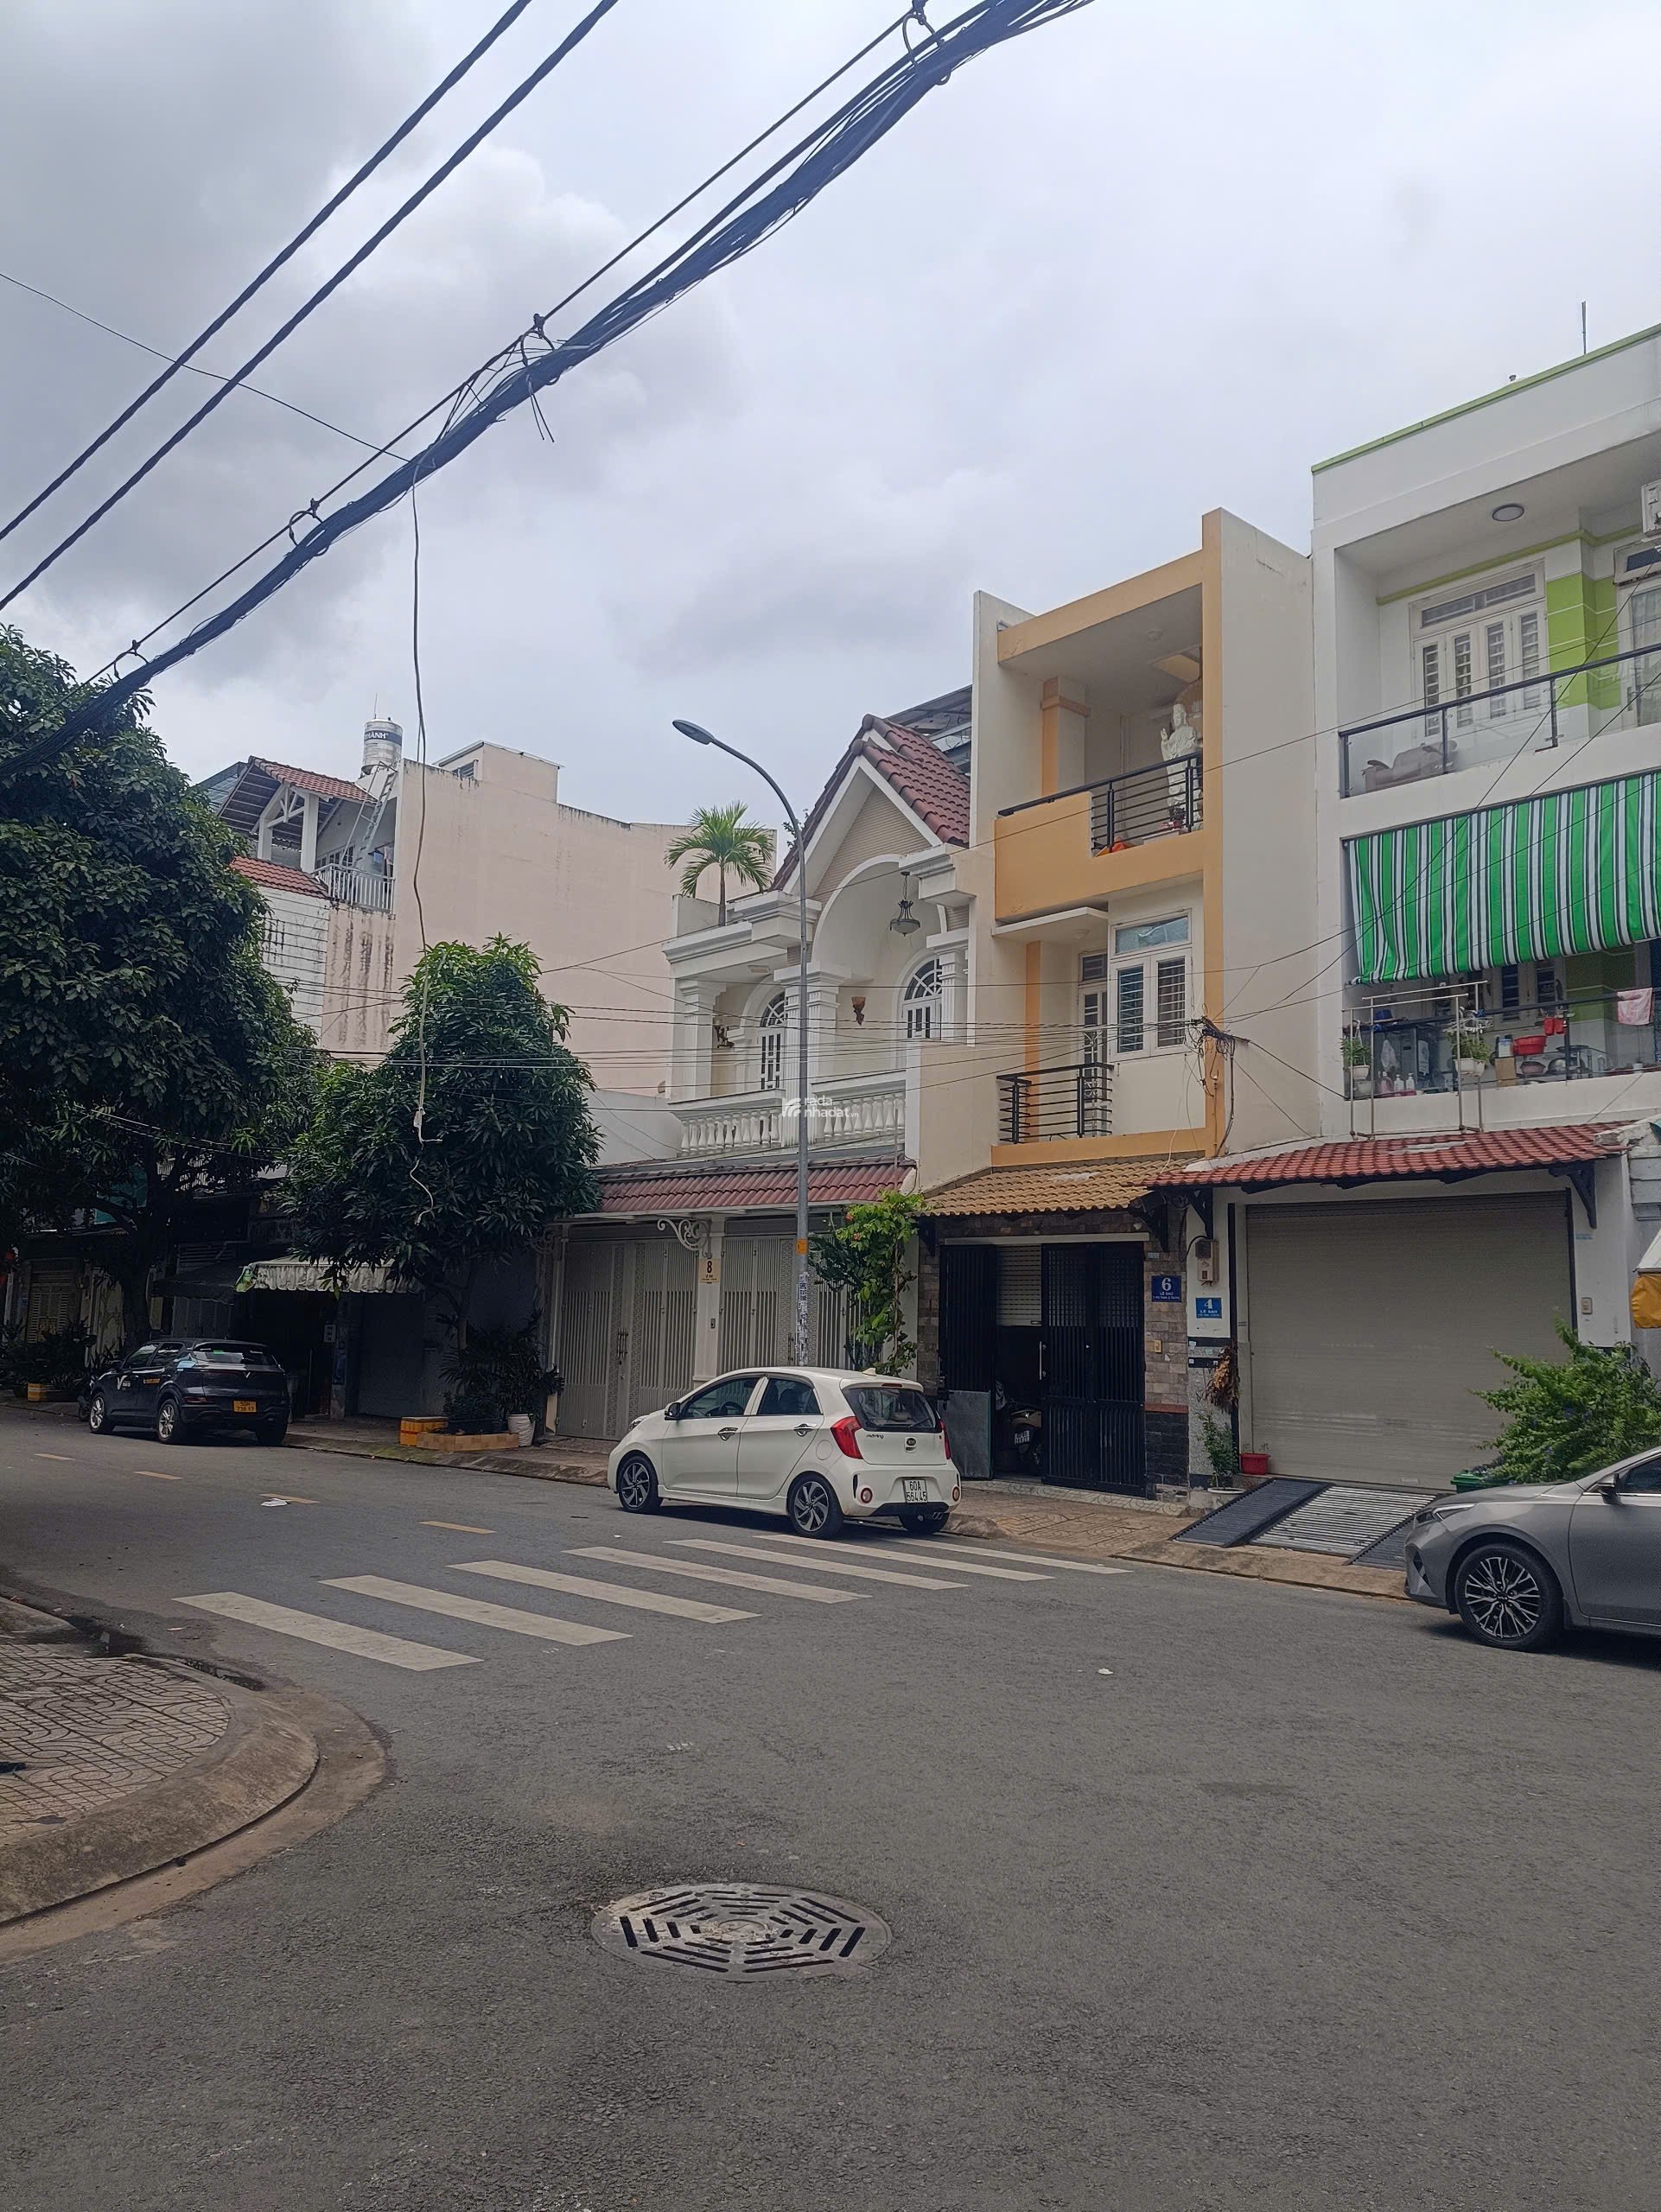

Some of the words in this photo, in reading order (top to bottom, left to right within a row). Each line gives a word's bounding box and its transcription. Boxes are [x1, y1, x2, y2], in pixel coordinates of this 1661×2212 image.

[706, 1260, 713, 1273] 8
[1161, 1277, 1172, 1292] 6
[1204, 1299, 1213, 1310] 4
[909, 1480, 922, 1491] 60A
